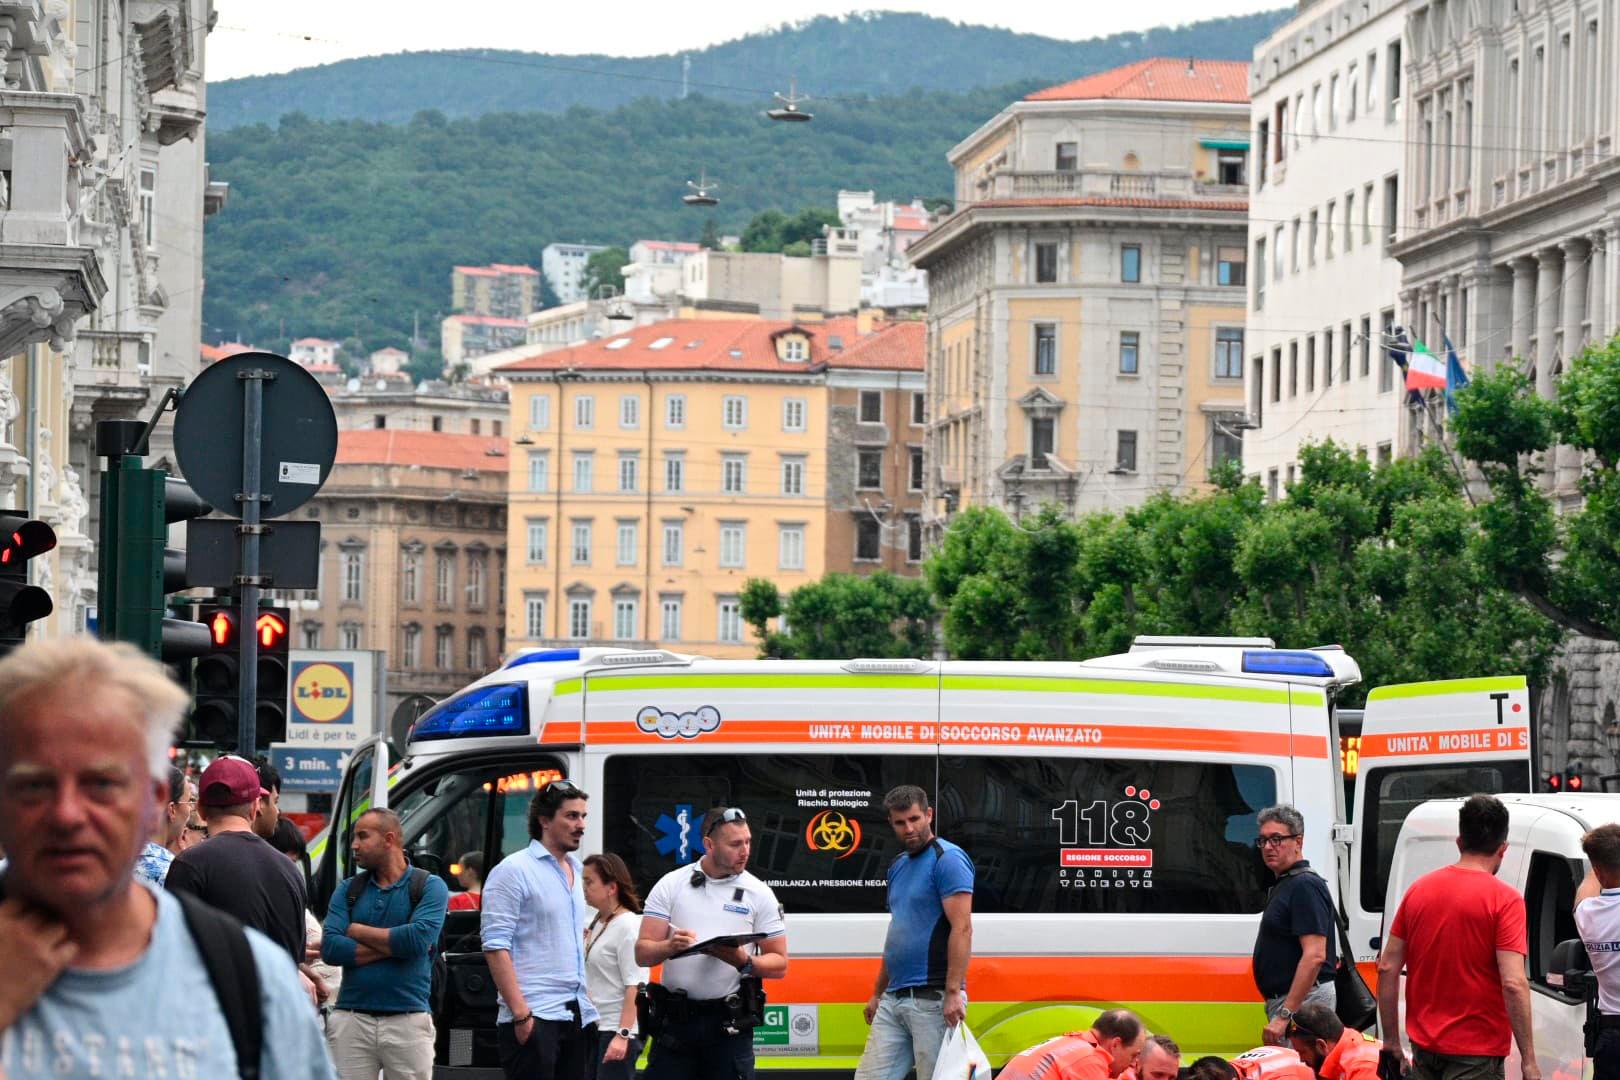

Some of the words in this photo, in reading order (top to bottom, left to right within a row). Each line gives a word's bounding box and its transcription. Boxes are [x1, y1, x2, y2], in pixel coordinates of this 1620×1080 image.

[1490, 693, 1509, 725] T
[288, 729, 309, 740] Lidl
[324, 731, 342, 742] per
[346, 731, 357, 740] te
[861, 724, 914, 740] MOBILE
[919, 725, 935, 740] DI
[940, 725, 1021, 742] SOCCORSO
[1027, 726, 1102, 743] AVANZATO
[1439, 734, 1491, 751] MOBILE
[1498, 733, 1512, 748] DI
[285, 757, 294, 770] 3
[299, 757, 331, 770] min.
[819, 788, 827, 797] di
[828, 789, 871, 799] protezione
[798, 799, 829, 807] Rischio
[830, 799, 869, 809] Biologico
[1051, 799, 1151, 846] 118
[1065, 854, 1102, 862] REGIONE
[1104, 854, 1147, 862] SOCCORSO
[812, 879, 819, 888] A
[820, 879, 863, 888] PRESSIONE
